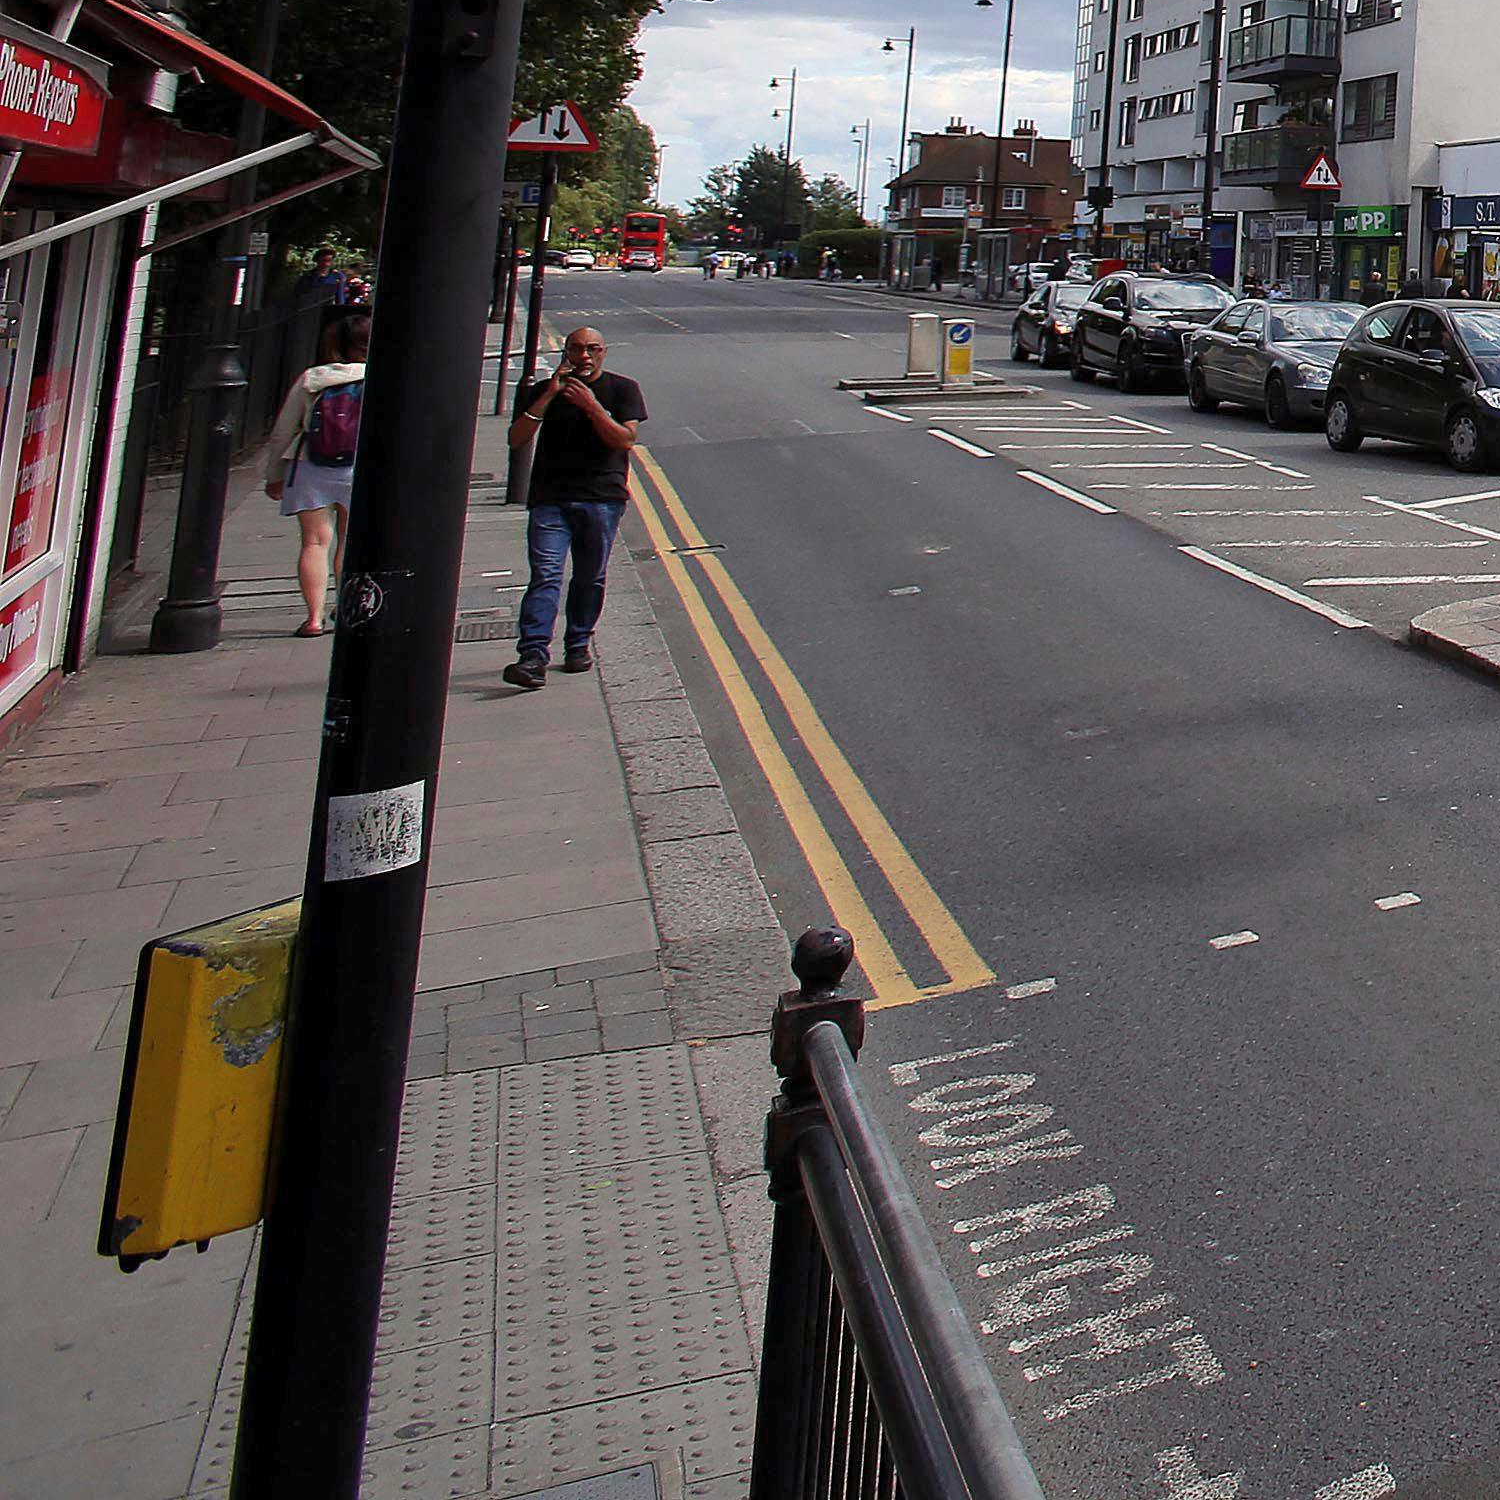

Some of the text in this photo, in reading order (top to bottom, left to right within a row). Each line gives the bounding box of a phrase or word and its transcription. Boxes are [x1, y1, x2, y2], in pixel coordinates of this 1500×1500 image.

[33, 59, 79, 133] Repairs
[1475, 201, 1497, 223] S.T.
[888, 1039, 1227, 1421] LOOK RIGHT
